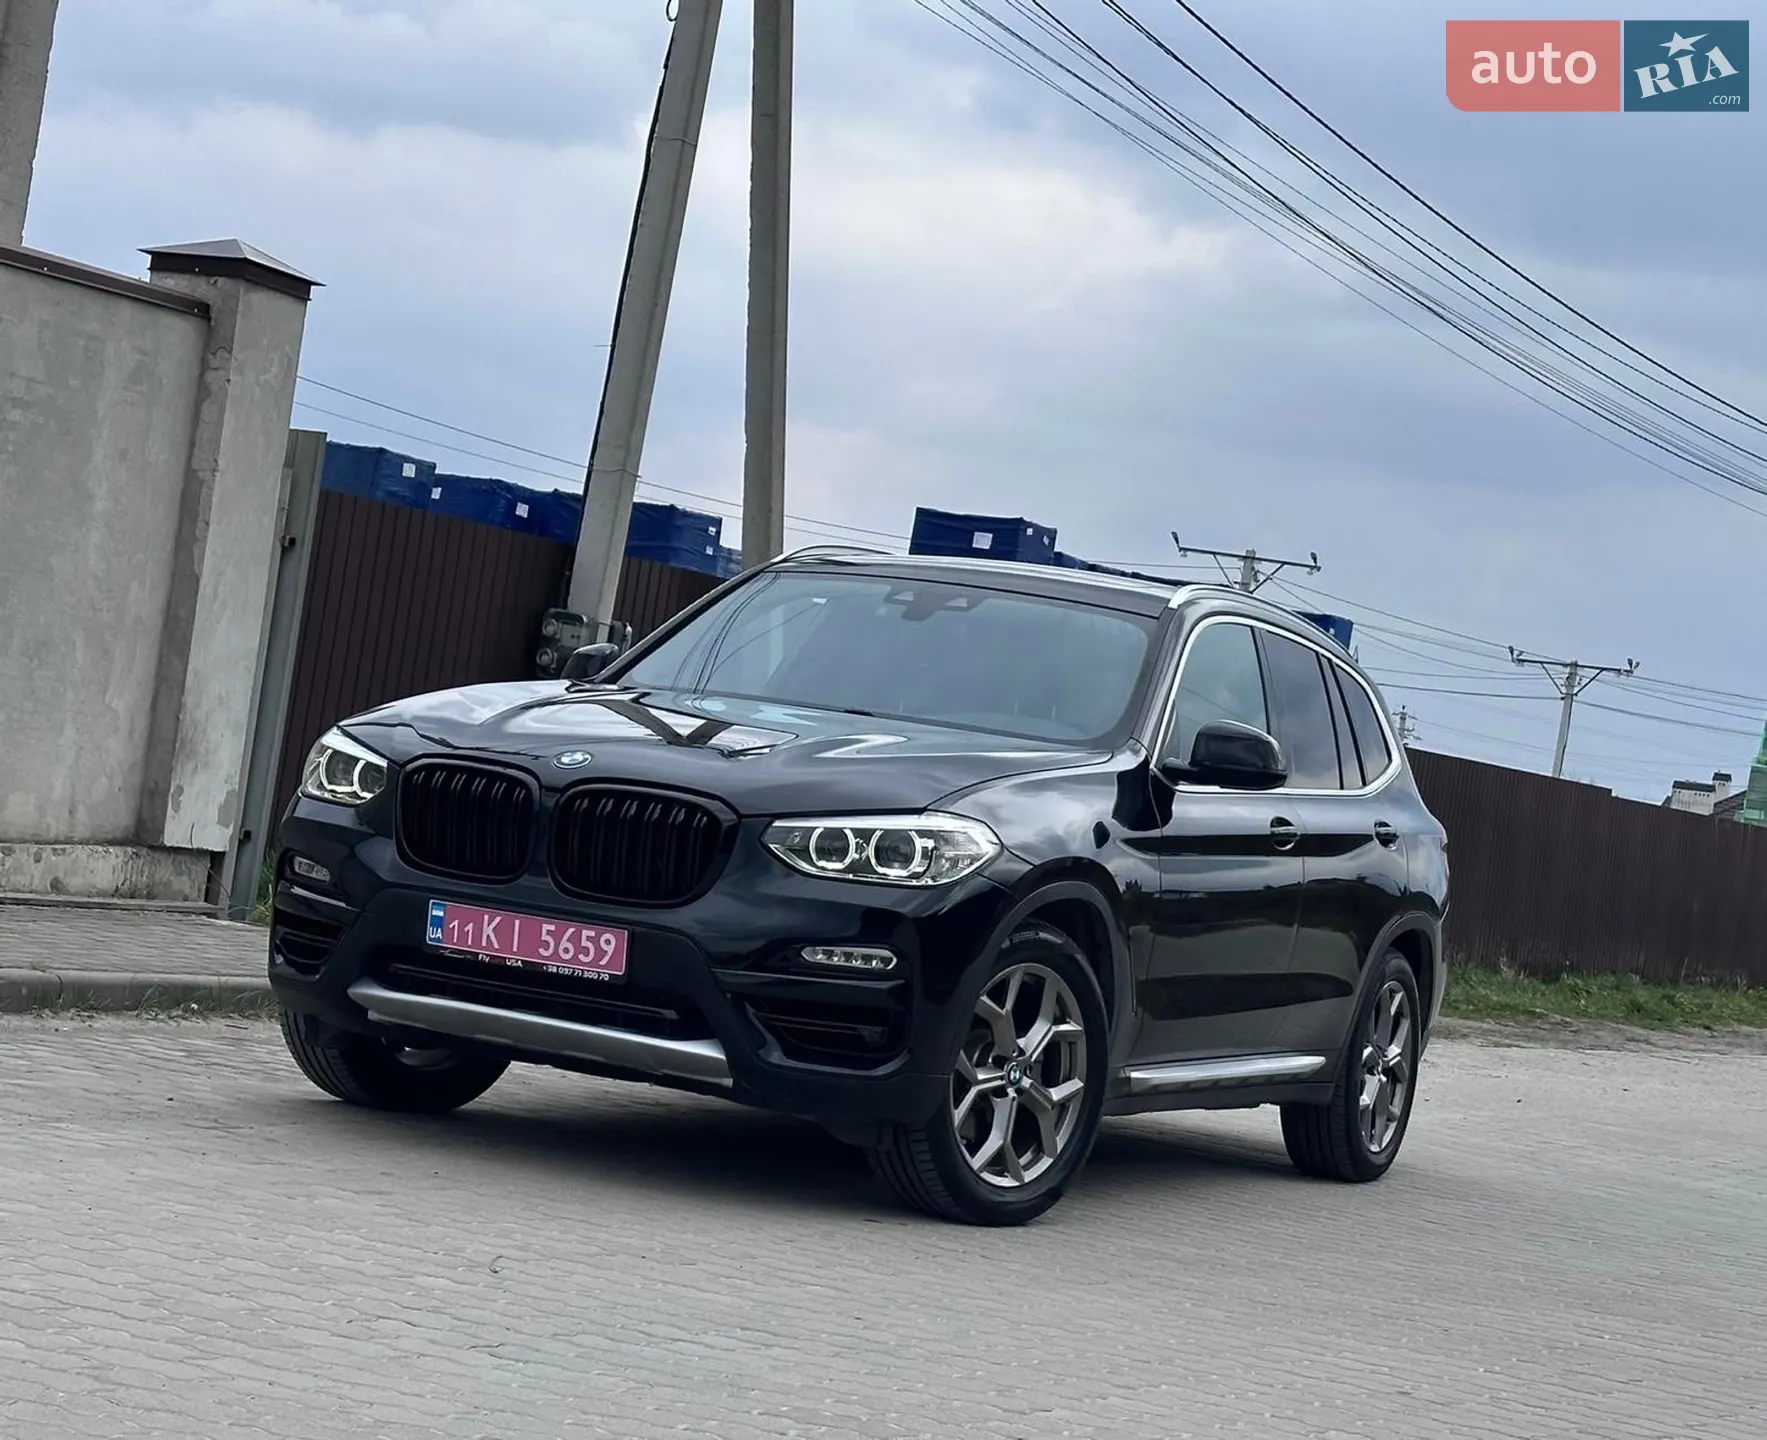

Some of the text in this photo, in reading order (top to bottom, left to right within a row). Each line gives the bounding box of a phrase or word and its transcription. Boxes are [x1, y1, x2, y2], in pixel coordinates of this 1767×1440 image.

[429, 927, 443, 940] UA
[538, 924, 617, 966] 5659
[506, 958, 523, 968] USA
